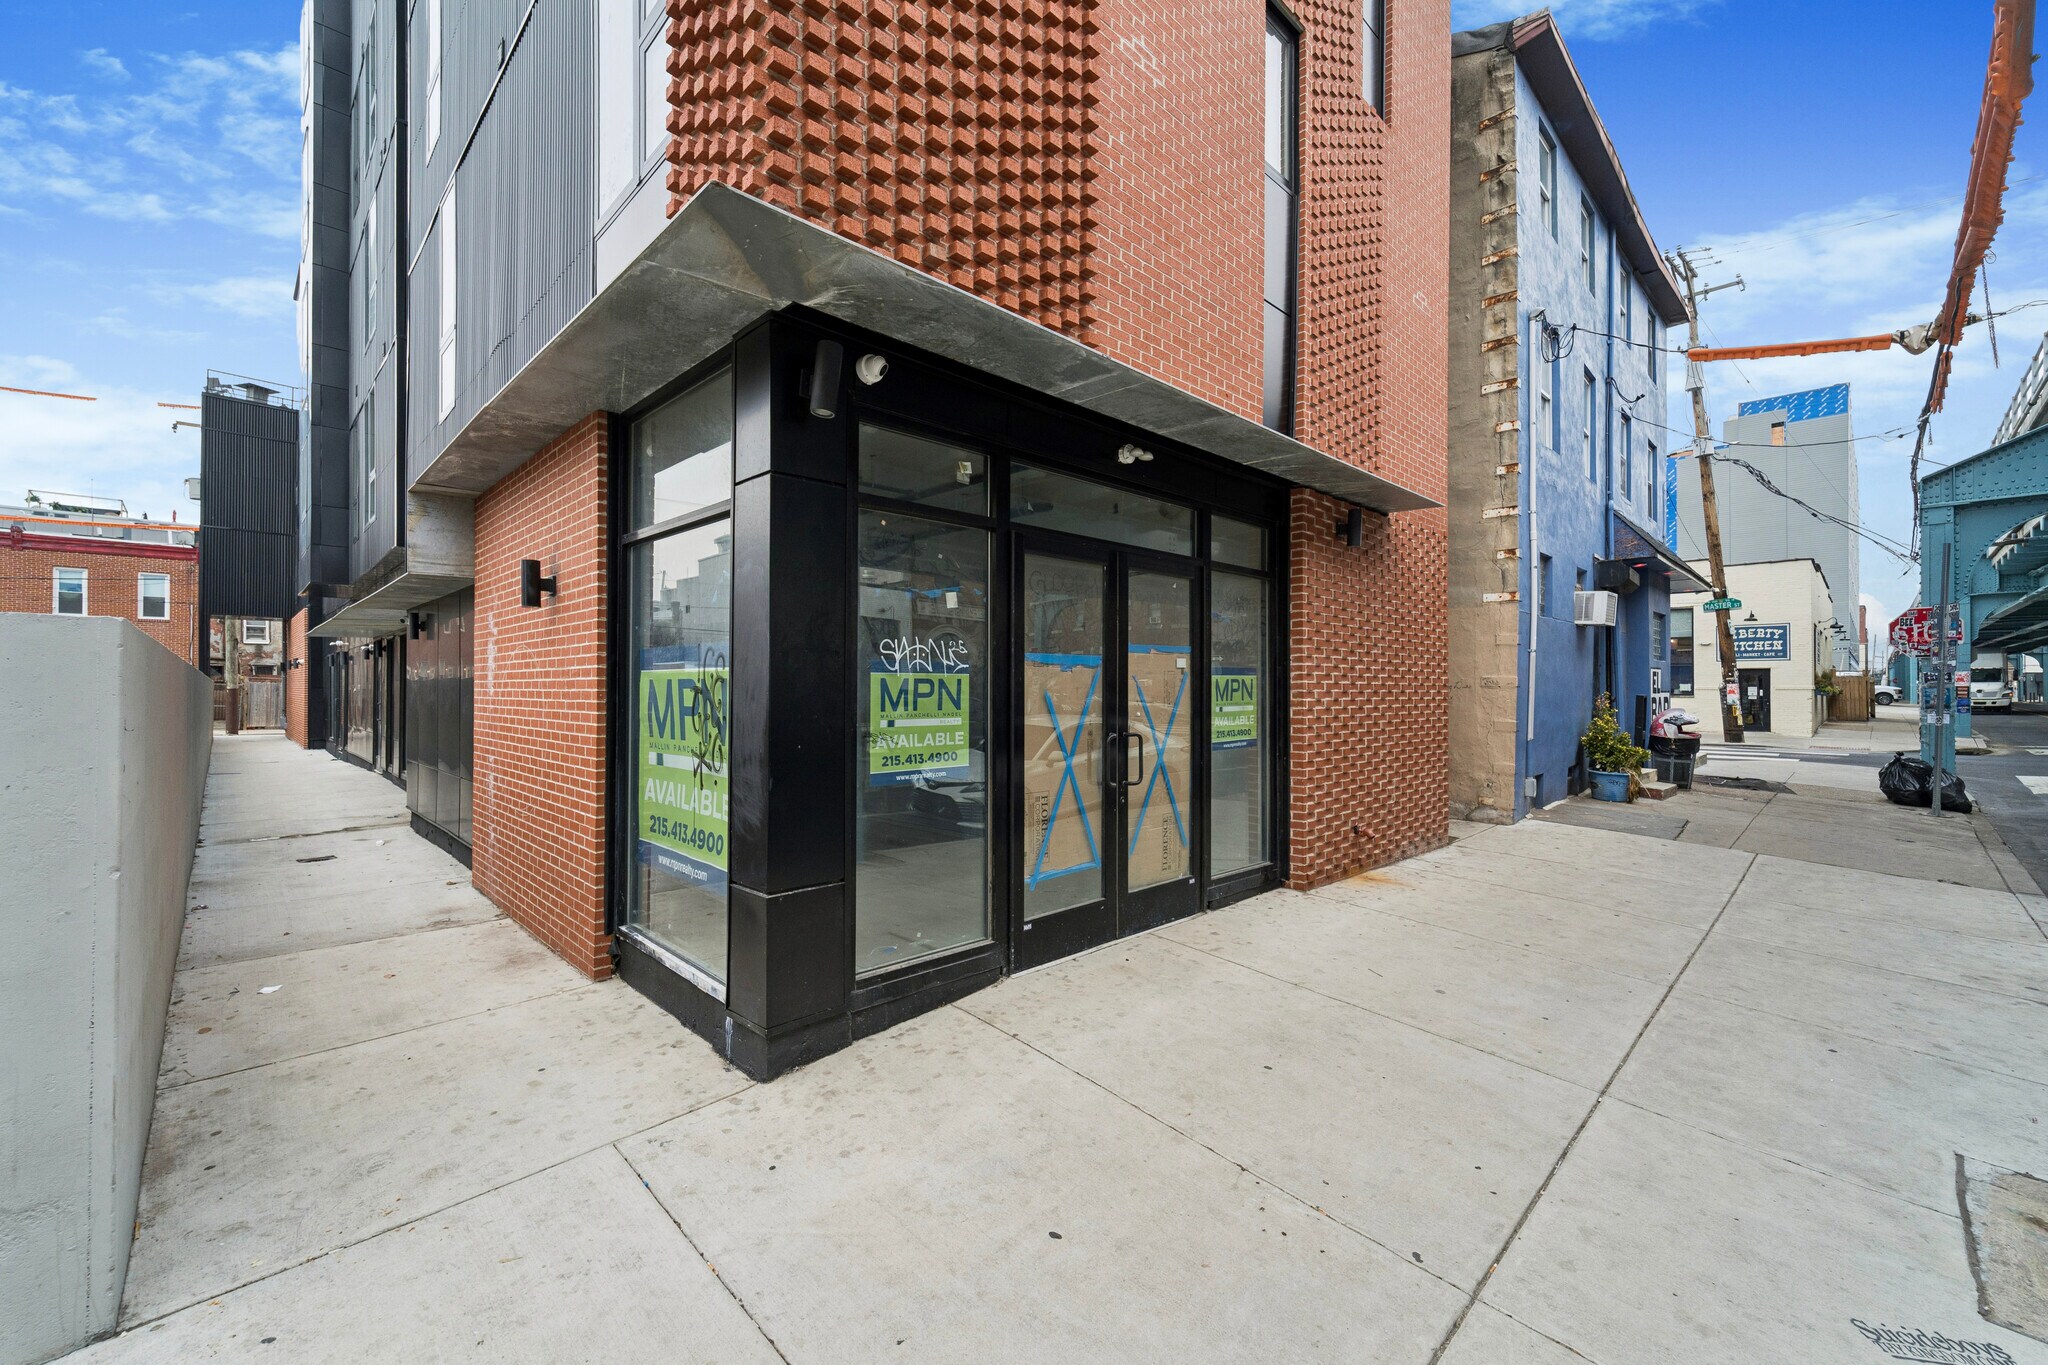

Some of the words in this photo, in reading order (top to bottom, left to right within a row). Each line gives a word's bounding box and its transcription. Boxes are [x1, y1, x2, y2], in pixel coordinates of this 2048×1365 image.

[1704, 602, 1732, 610] MASTER
[1900, 617, 1913, 626] BEE
[1733, 628, 1784, 639] IBERTY
[1733, 640, 1783, 651] ITCHEN
[1215, 678, 1254, 702] MPN
[1652, 671, 1660, 694] EL
[880, 678, 962, 712] MPN
[648, 678, 728, 747] MPN
[1214, 715, 1255, 727] AVAILABLE
[876, 732, 964, 750] AVAILABLE
[1216, 729, 1252, 739] 215.413.4900
[881, 751, 958, 767] 215.413.4900
[896, 770, 947, 781] www.mpnrealty.com
[644, 777, 728, 823] AVAILABLE
[649, 815, 724, 856] 215.413.4900
[1041, 795, 1049, 859] FLOREE
[657, 854, 708, 883] www.mpnrealty.com
[1872, 1339, 1908, 1355] THY
[1903, 1344, 1979, 1365] KINGDOM
